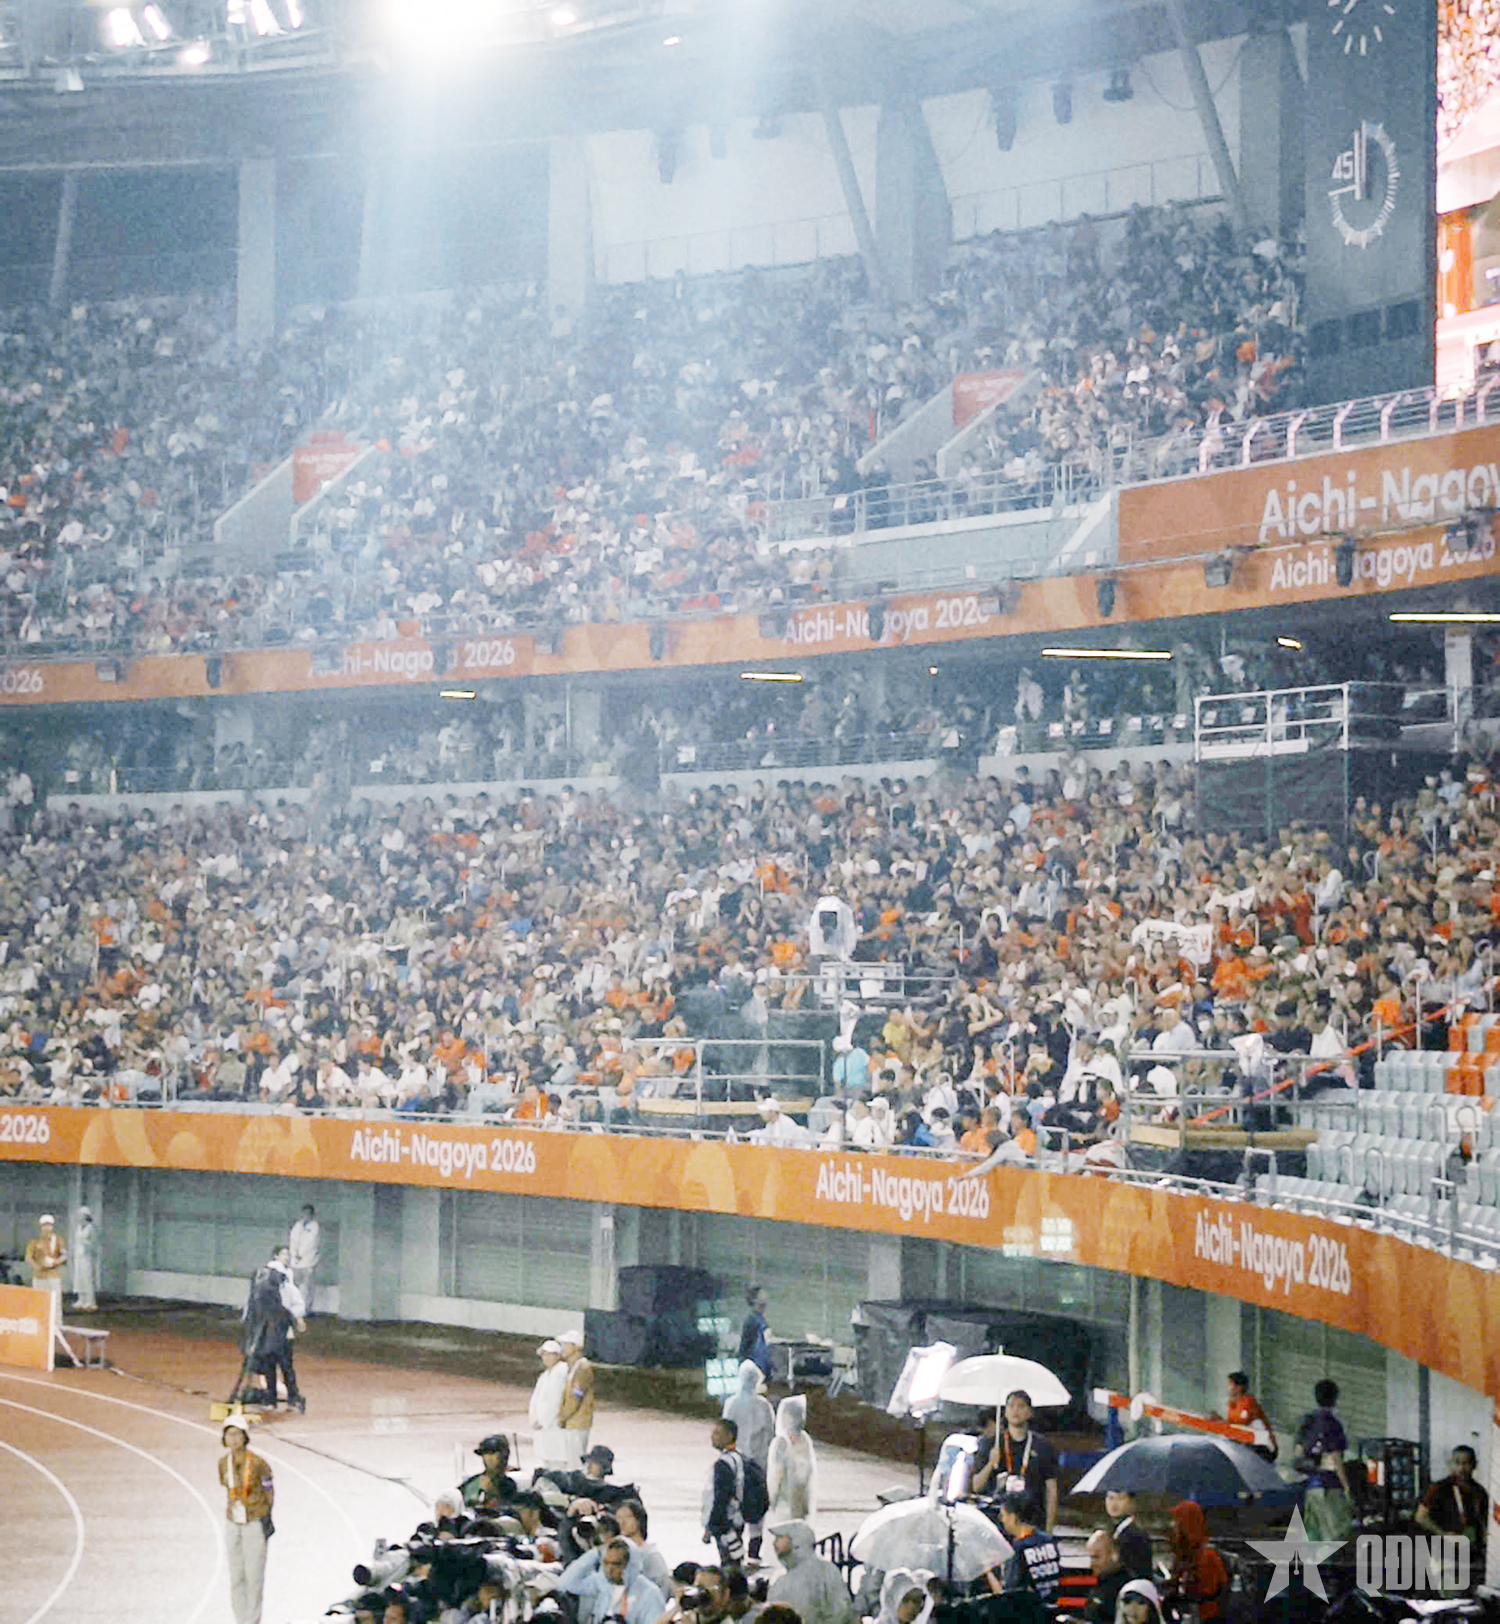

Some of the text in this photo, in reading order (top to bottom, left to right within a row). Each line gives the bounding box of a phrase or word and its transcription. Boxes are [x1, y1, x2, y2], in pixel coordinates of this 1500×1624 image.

[1332, 150, 1354, 179] 45
[1269, 542, 1434, 592] Aichi-agoya
[463, 640, 515, 668] 2026
[0, 1114, 50, 1144] 2026
[350, 1127, 537, 1179] Aichi-Nagoya 2026
[815, 1159, 990, 1224] Aichi-Nagoya 2026
[1194, 1207, 1352, 1296] Aichi-Nagoya 2026
